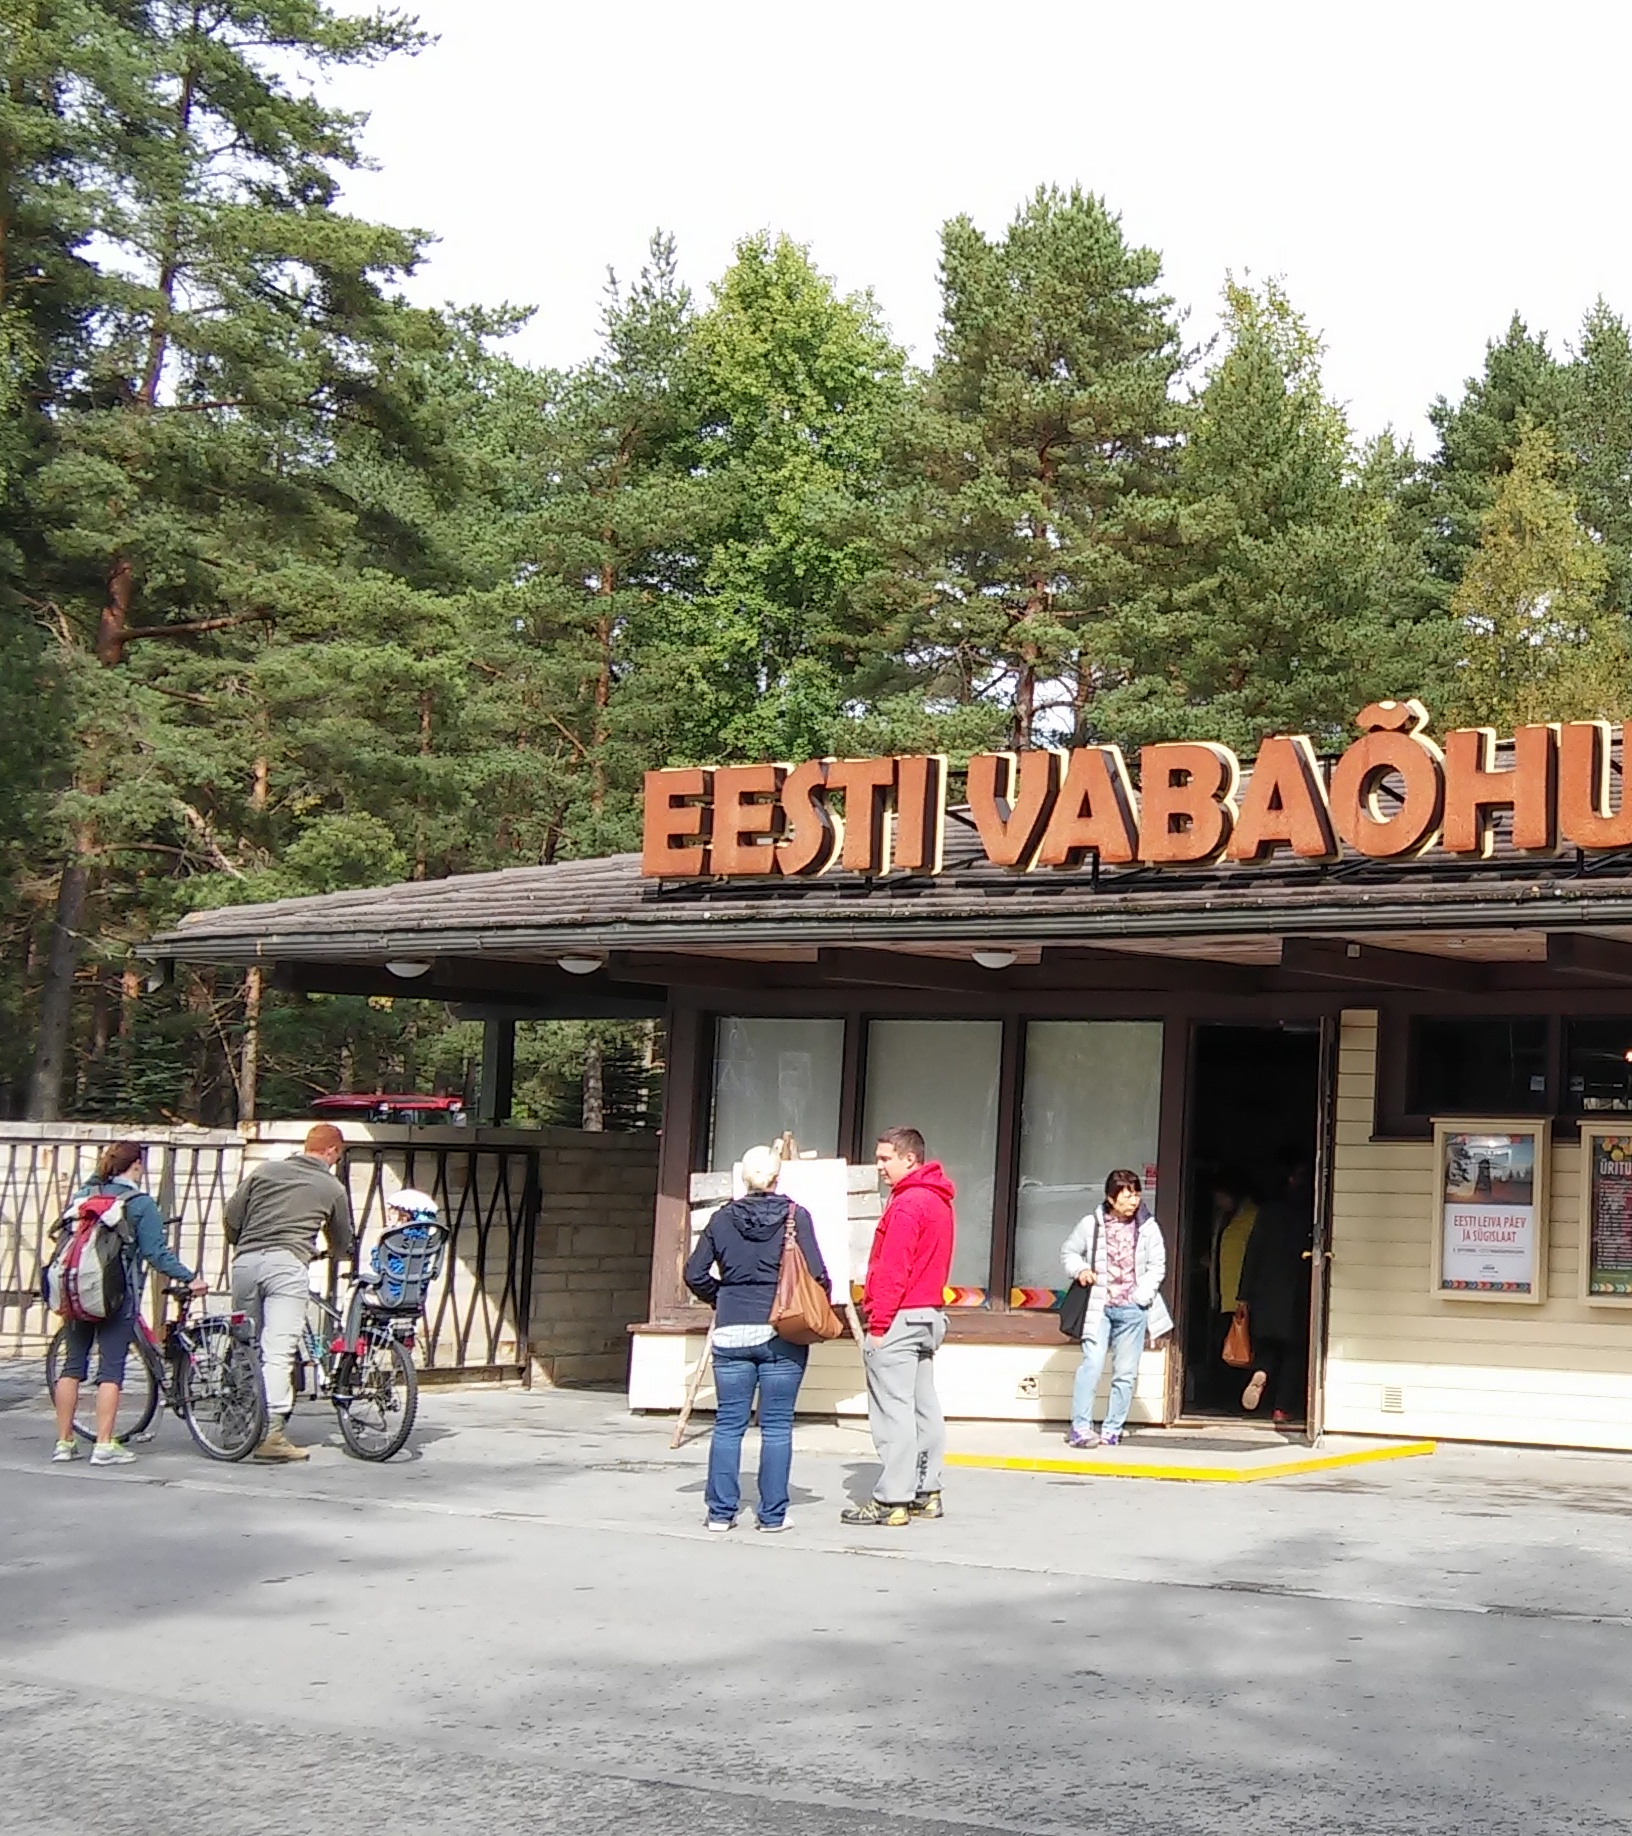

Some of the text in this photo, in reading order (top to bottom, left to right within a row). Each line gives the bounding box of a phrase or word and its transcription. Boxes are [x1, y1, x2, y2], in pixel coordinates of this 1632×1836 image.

[643, 754, 947, 878] EESTI
[1454, 1214, 1527, 1228] EESTI LEIVA PÄEV
[1462, 1228, 1516, 1242] JA SÜGISLAAT
